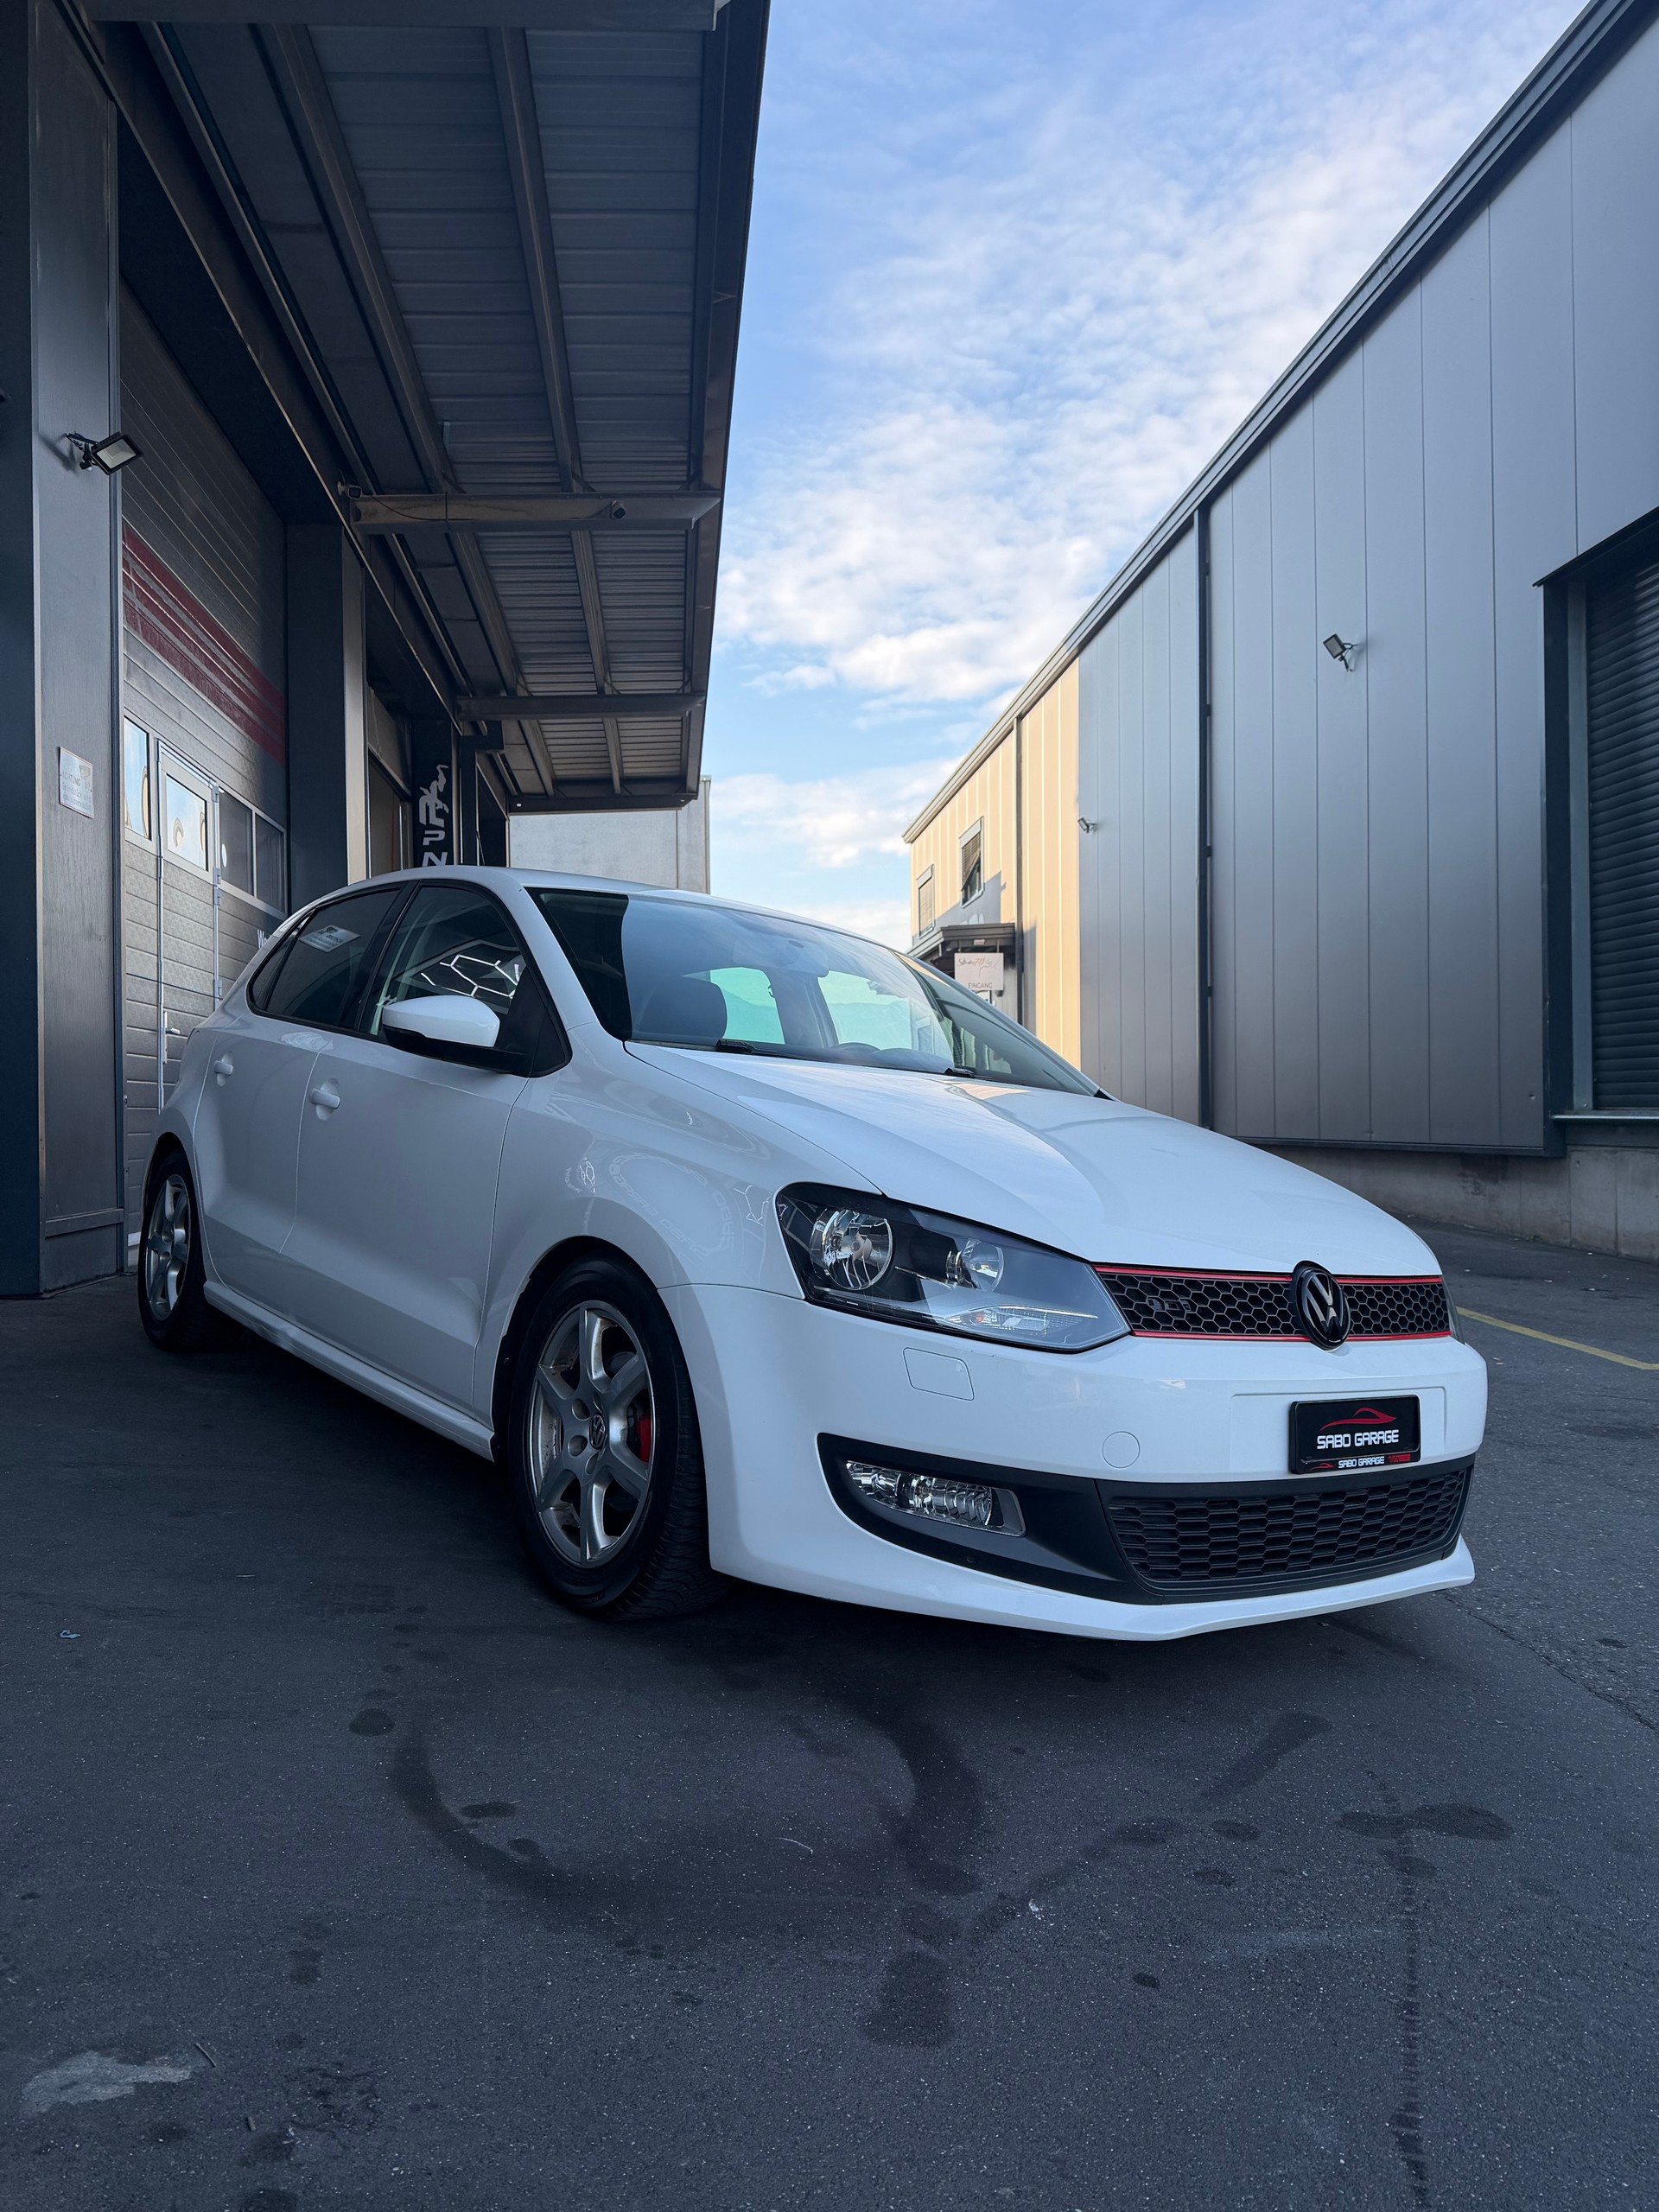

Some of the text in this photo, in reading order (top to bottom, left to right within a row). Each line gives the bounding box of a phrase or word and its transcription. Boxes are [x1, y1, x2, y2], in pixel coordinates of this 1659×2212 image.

[1316, 1428, 1400, 1450] SABO GARAGE
[1338, 1459, 1357, 1469] SABO
[1357, 1455, 1385, 1467] GARAGE
